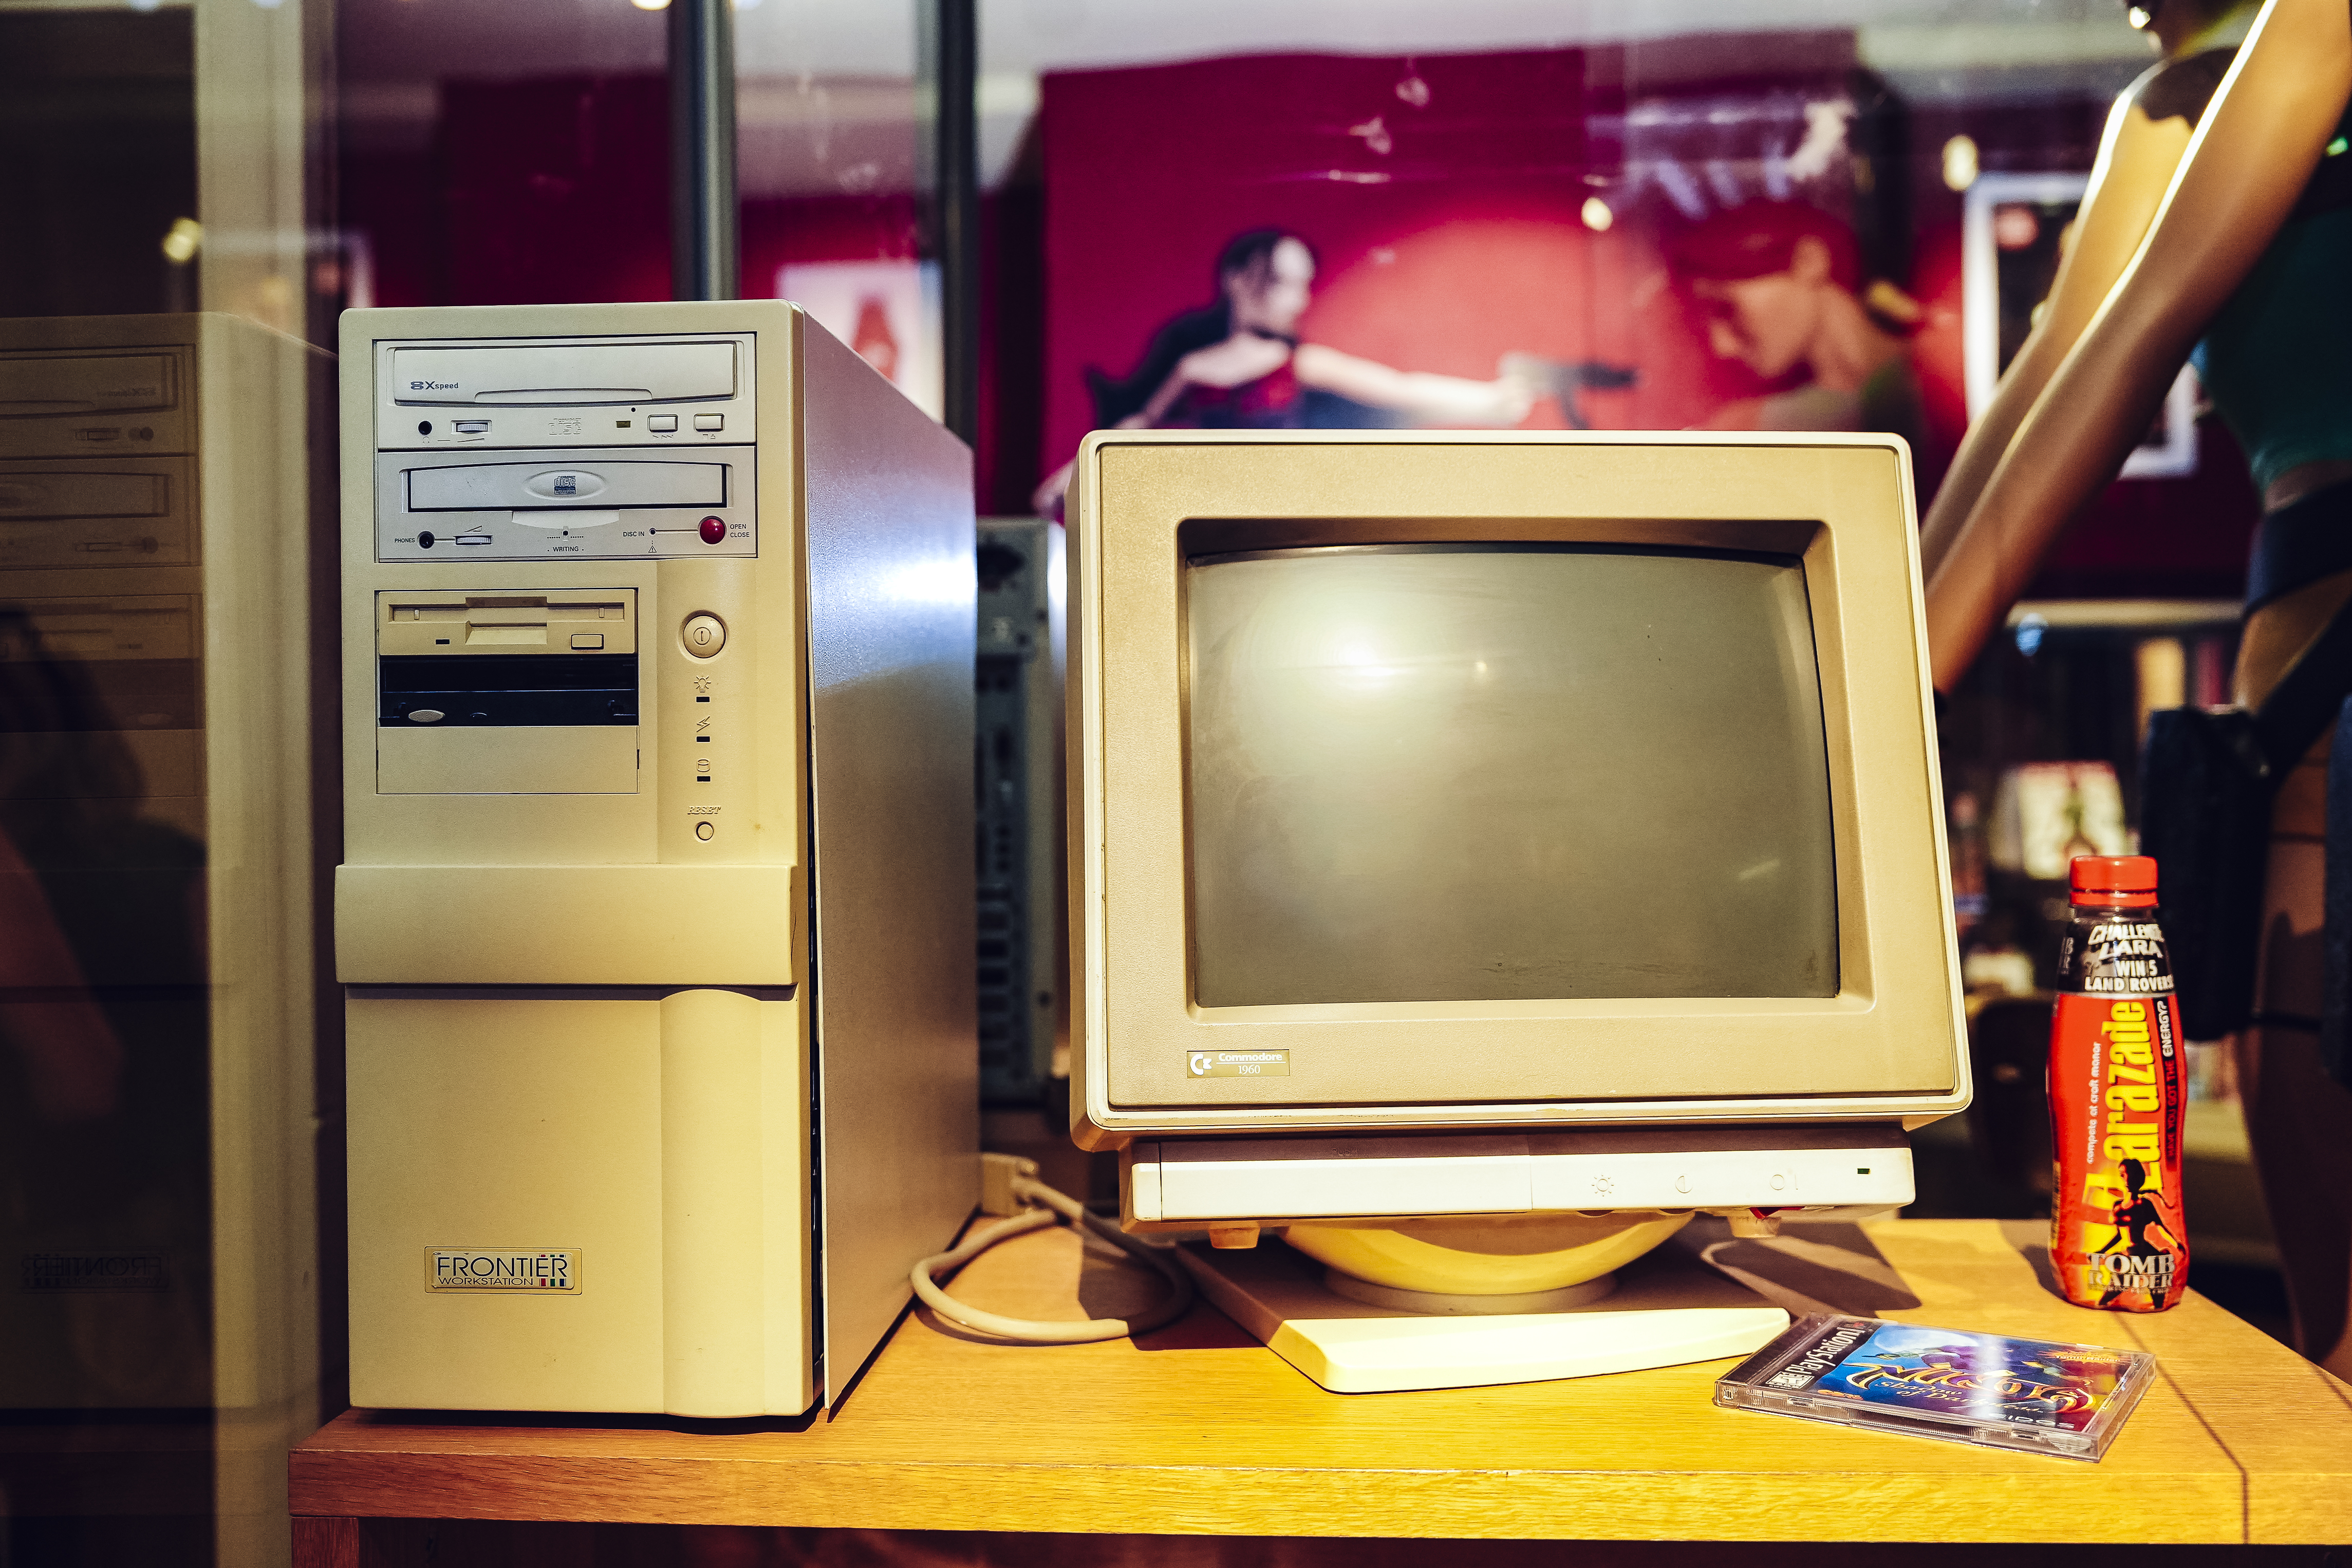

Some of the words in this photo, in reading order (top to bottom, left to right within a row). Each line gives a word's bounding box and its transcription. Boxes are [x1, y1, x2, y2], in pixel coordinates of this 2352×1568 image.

[687, 805, 722, 815] RESET
[2099, 940, 2163, 961] LARA
[2115, 960, 2146, 977] WIN
[2149, 959, 2158, 976] 5
[2084, 977, 2125, 991] LAND
[2157, 1000, 2174, 1057] ENERGY?
[1218, 1053, 1283, 1062] Commodore
[2091, 1041, 2101, 1078] manor
[1238, 1064, 1261, 1075] 1960
[2164, 1060, 2176, 1080] THE
[2088, 1079, 2100, 1104] croft
[2166, 1085, 2178, 1106] GOT
[2088, 1105, 2099, 1117] at
[2167, 1109, 2177, 1129] YOU
[2086, 1119, 2098, 1165] compete
[2167, 1132, 2176, 1157] HAVE
[437, 1257, 568, 1278] FRONTIER
[2086, 1252, 2176, 1274] TOMB
[438, 1277, 533, 1285] WORKSTATION
[2087, 1270, 2173, 1287] RAIDER
[1784, 1329, 1861, 1375] PlayStation
[1875, 1382, 1963, 1395] Shadow
[1988, 1413, 2075, 1429] EIDOS
